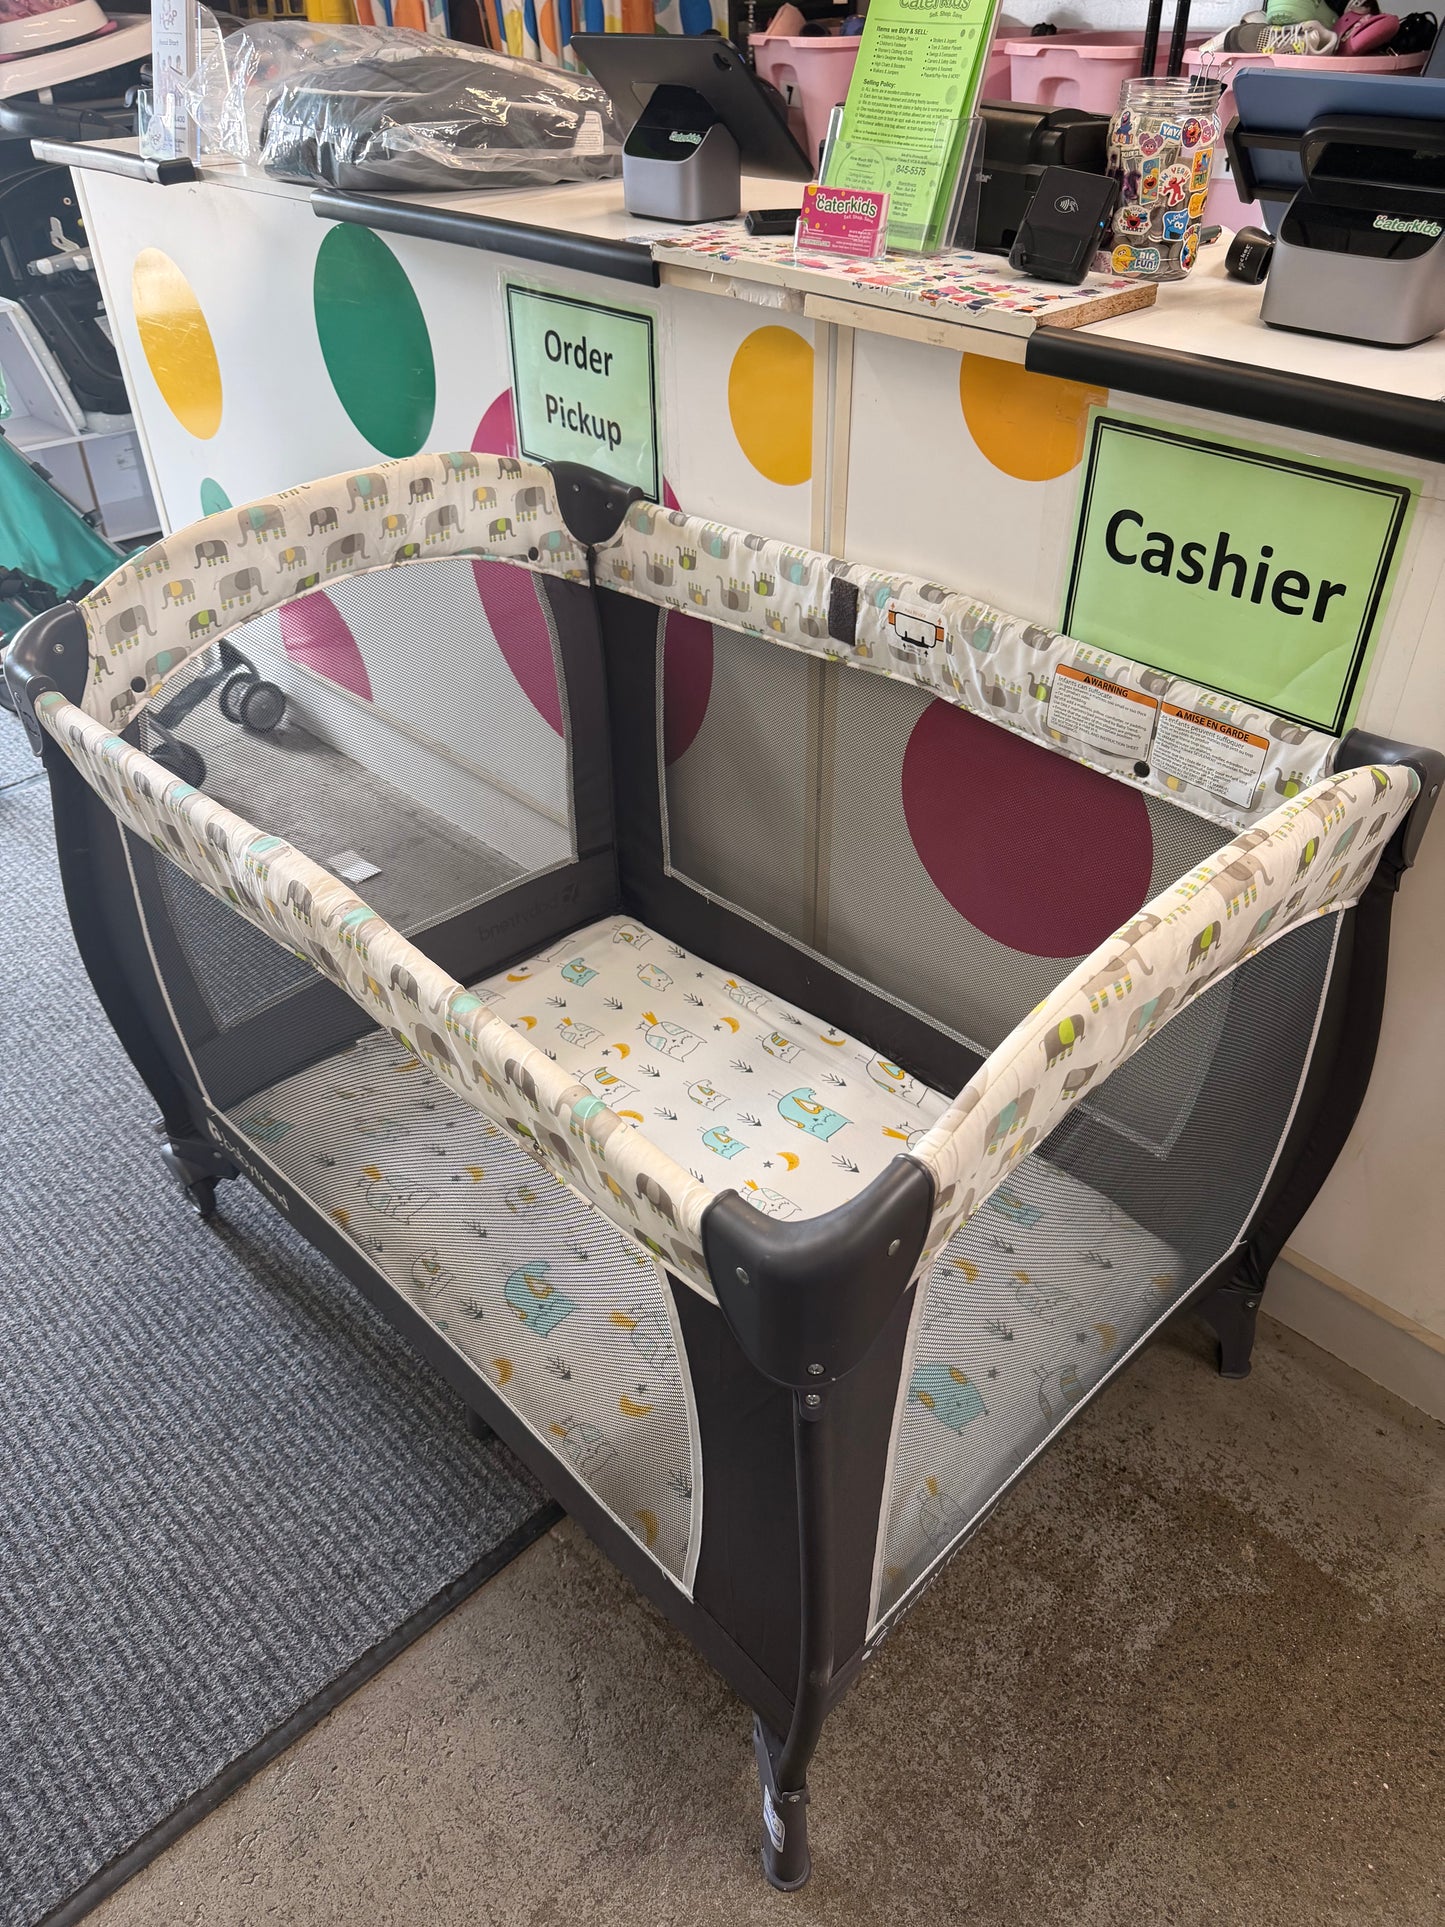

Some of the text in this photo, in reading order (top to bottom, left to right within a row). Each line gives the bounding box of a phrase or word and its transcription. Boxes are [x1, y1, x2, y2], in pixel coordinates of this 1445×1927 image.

[876, 25, 890, 33] Items
[863, 78, 896, 89] Selling Policy:
[1163, 125, 1181, 140] YAY!
[896, 165, 926, 176] 845-5575
[544, 330, 614, 376] Order
[545, 394, 622, 451] Pickup
[1105, 509, 1347, 623] Cashier
[1077, 682, 1087, 690] can
[1090, 677, 1128, 697] WARNING
[1183, 711, 1249, 742] MISE EN GARDE
